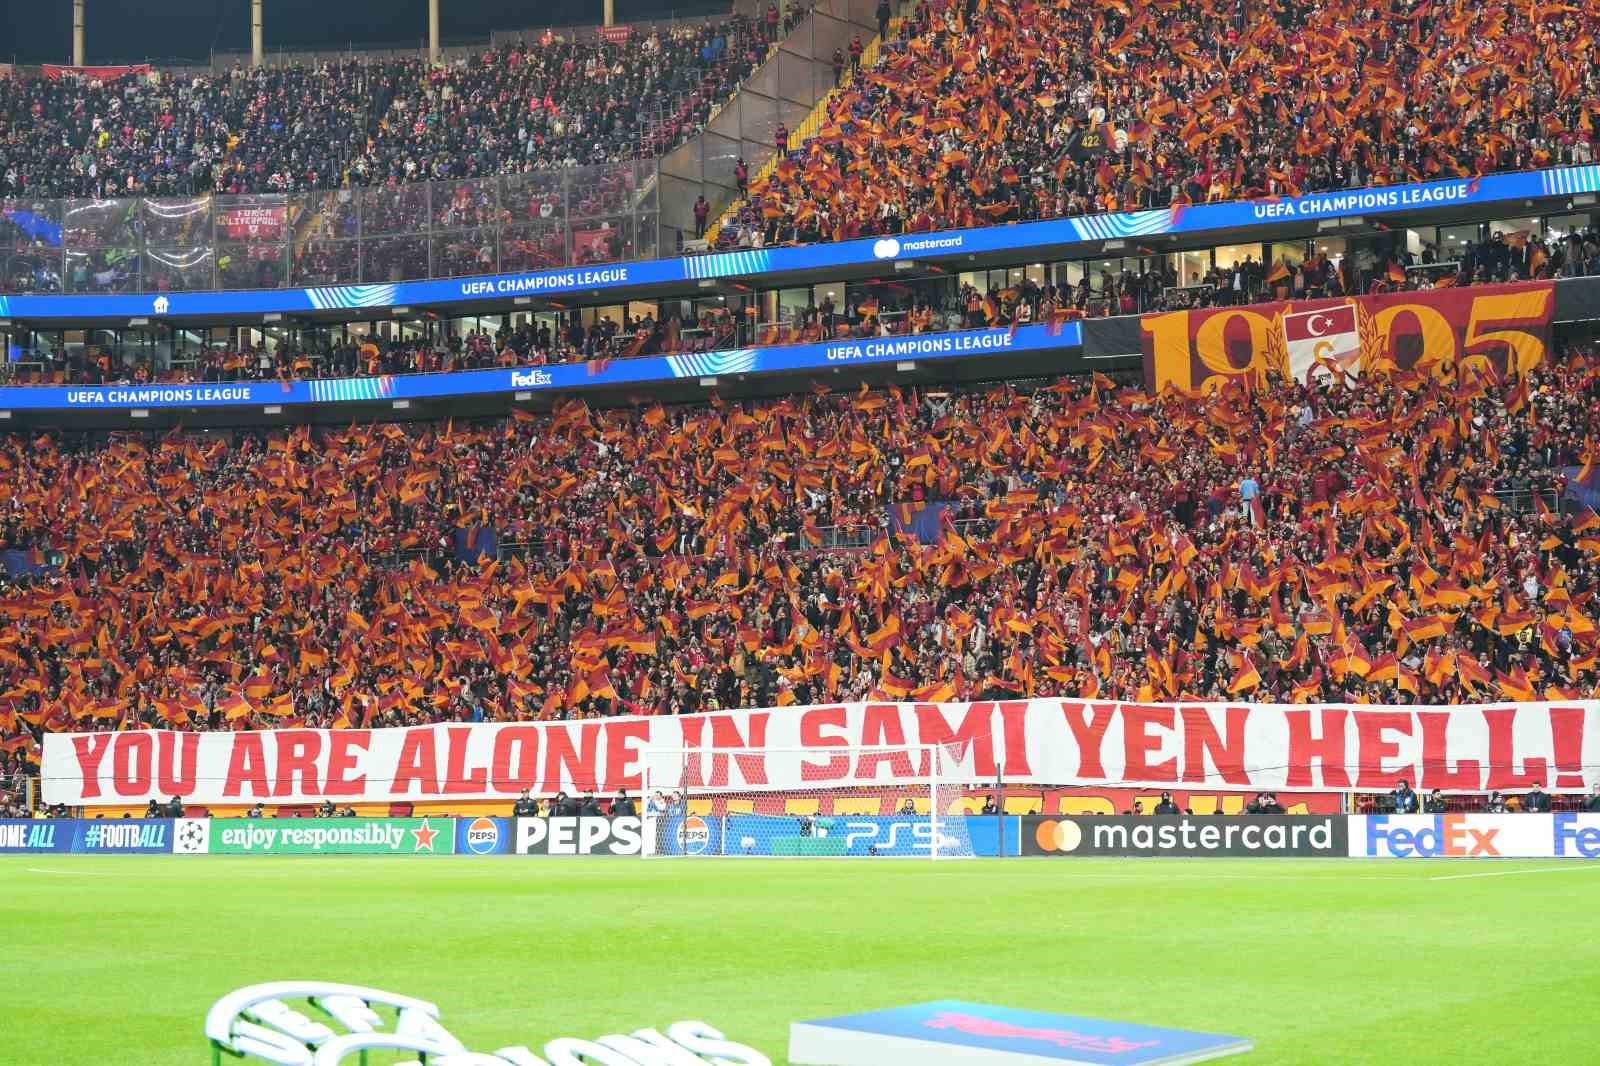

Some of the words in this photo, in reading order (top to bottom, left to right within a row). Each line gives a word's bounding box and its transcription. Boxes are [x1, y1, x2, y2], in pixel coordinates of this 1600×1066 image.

[1254, 202, 1295, 218] UEFA
[1299, 191, 1398, 215] CHAMPIONS
[1402, 184, 1468, 204] LEAGUE
[903, 236, 963, 251] mastercard
[462, 281, 495, 295] UEFA
[497, 273, 575, 292] CHAMPIONS
[577, 268, 628, 285] LEAGUE
[827, 346, 863, 361] UEFA
[866, 338, 952, 357] CHAMPIONS
[955, 333, 1012, 350] LEAGUE
[1141, 288, 1554, 397] 1905
[511, 370, 552, 387] FedEx
[67, 391, 104, 403] UEFA
[108, 388, 193, 403] CHAMPIONS
[196, 387, 251, 401] LEAGUE
[71, 730, 200, 799] YOU
[222, 730, 373, 798] ARE
[389, 720, 650, 795] ALONE
[679, 713, 772, 788] IN
[800, 702, 1033, 782] SAMI
[1060, 702, 1252, 786] YEN
[1284, 707, 1586, 791] HELL!
[27, 824, 56, 848] ALL
[84, 823, 166, 849] #FOOTBALL
[221, 823, 278, 849] enjoy
[280, 823, 405, 849] responsibly
[469, 831, 497, 841] PEPSI
[678, 831, 708, 841] PEPSI
[846, 822, 946, 849] PS5
[1094, 819, 1333, 850] mastercard
[1366, 813, 1501, 858] FedEx
